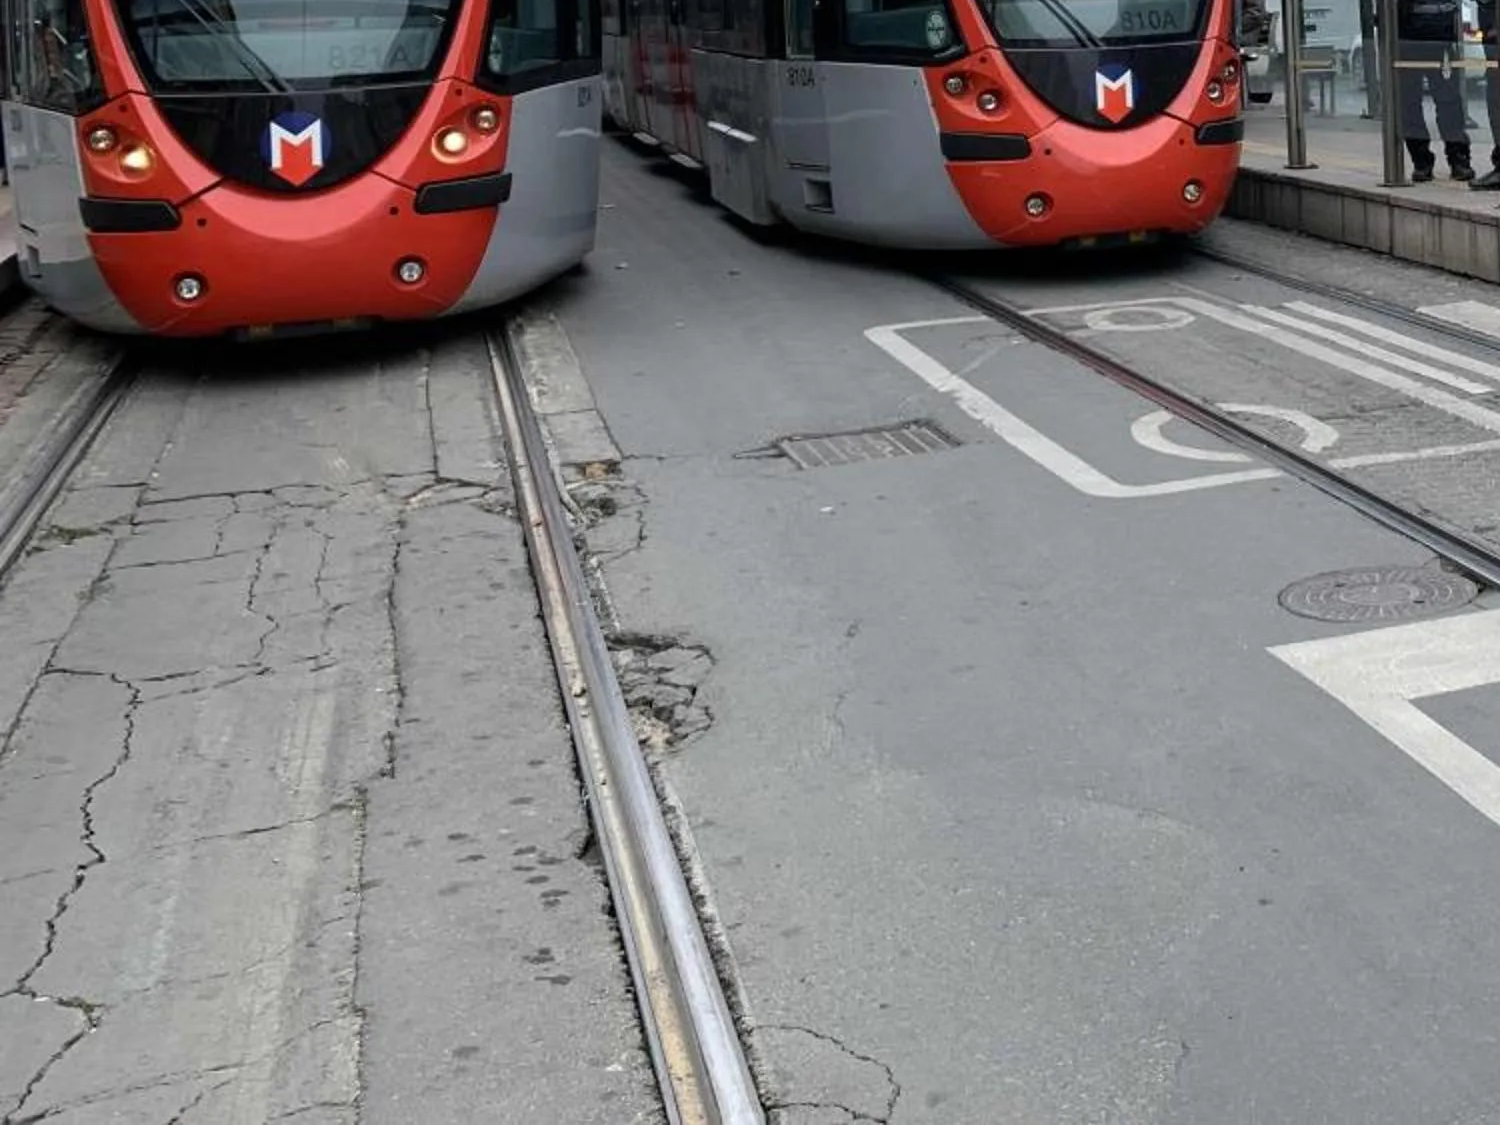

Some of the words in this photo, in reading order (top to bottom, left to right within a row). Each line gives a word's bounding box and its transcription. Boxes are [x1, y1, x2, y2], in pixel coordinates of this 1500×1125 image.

[1121, 10, 1178, 30] 810A
[330, 43, 408, 69] 821A
[269, 118, 324, 171] M
